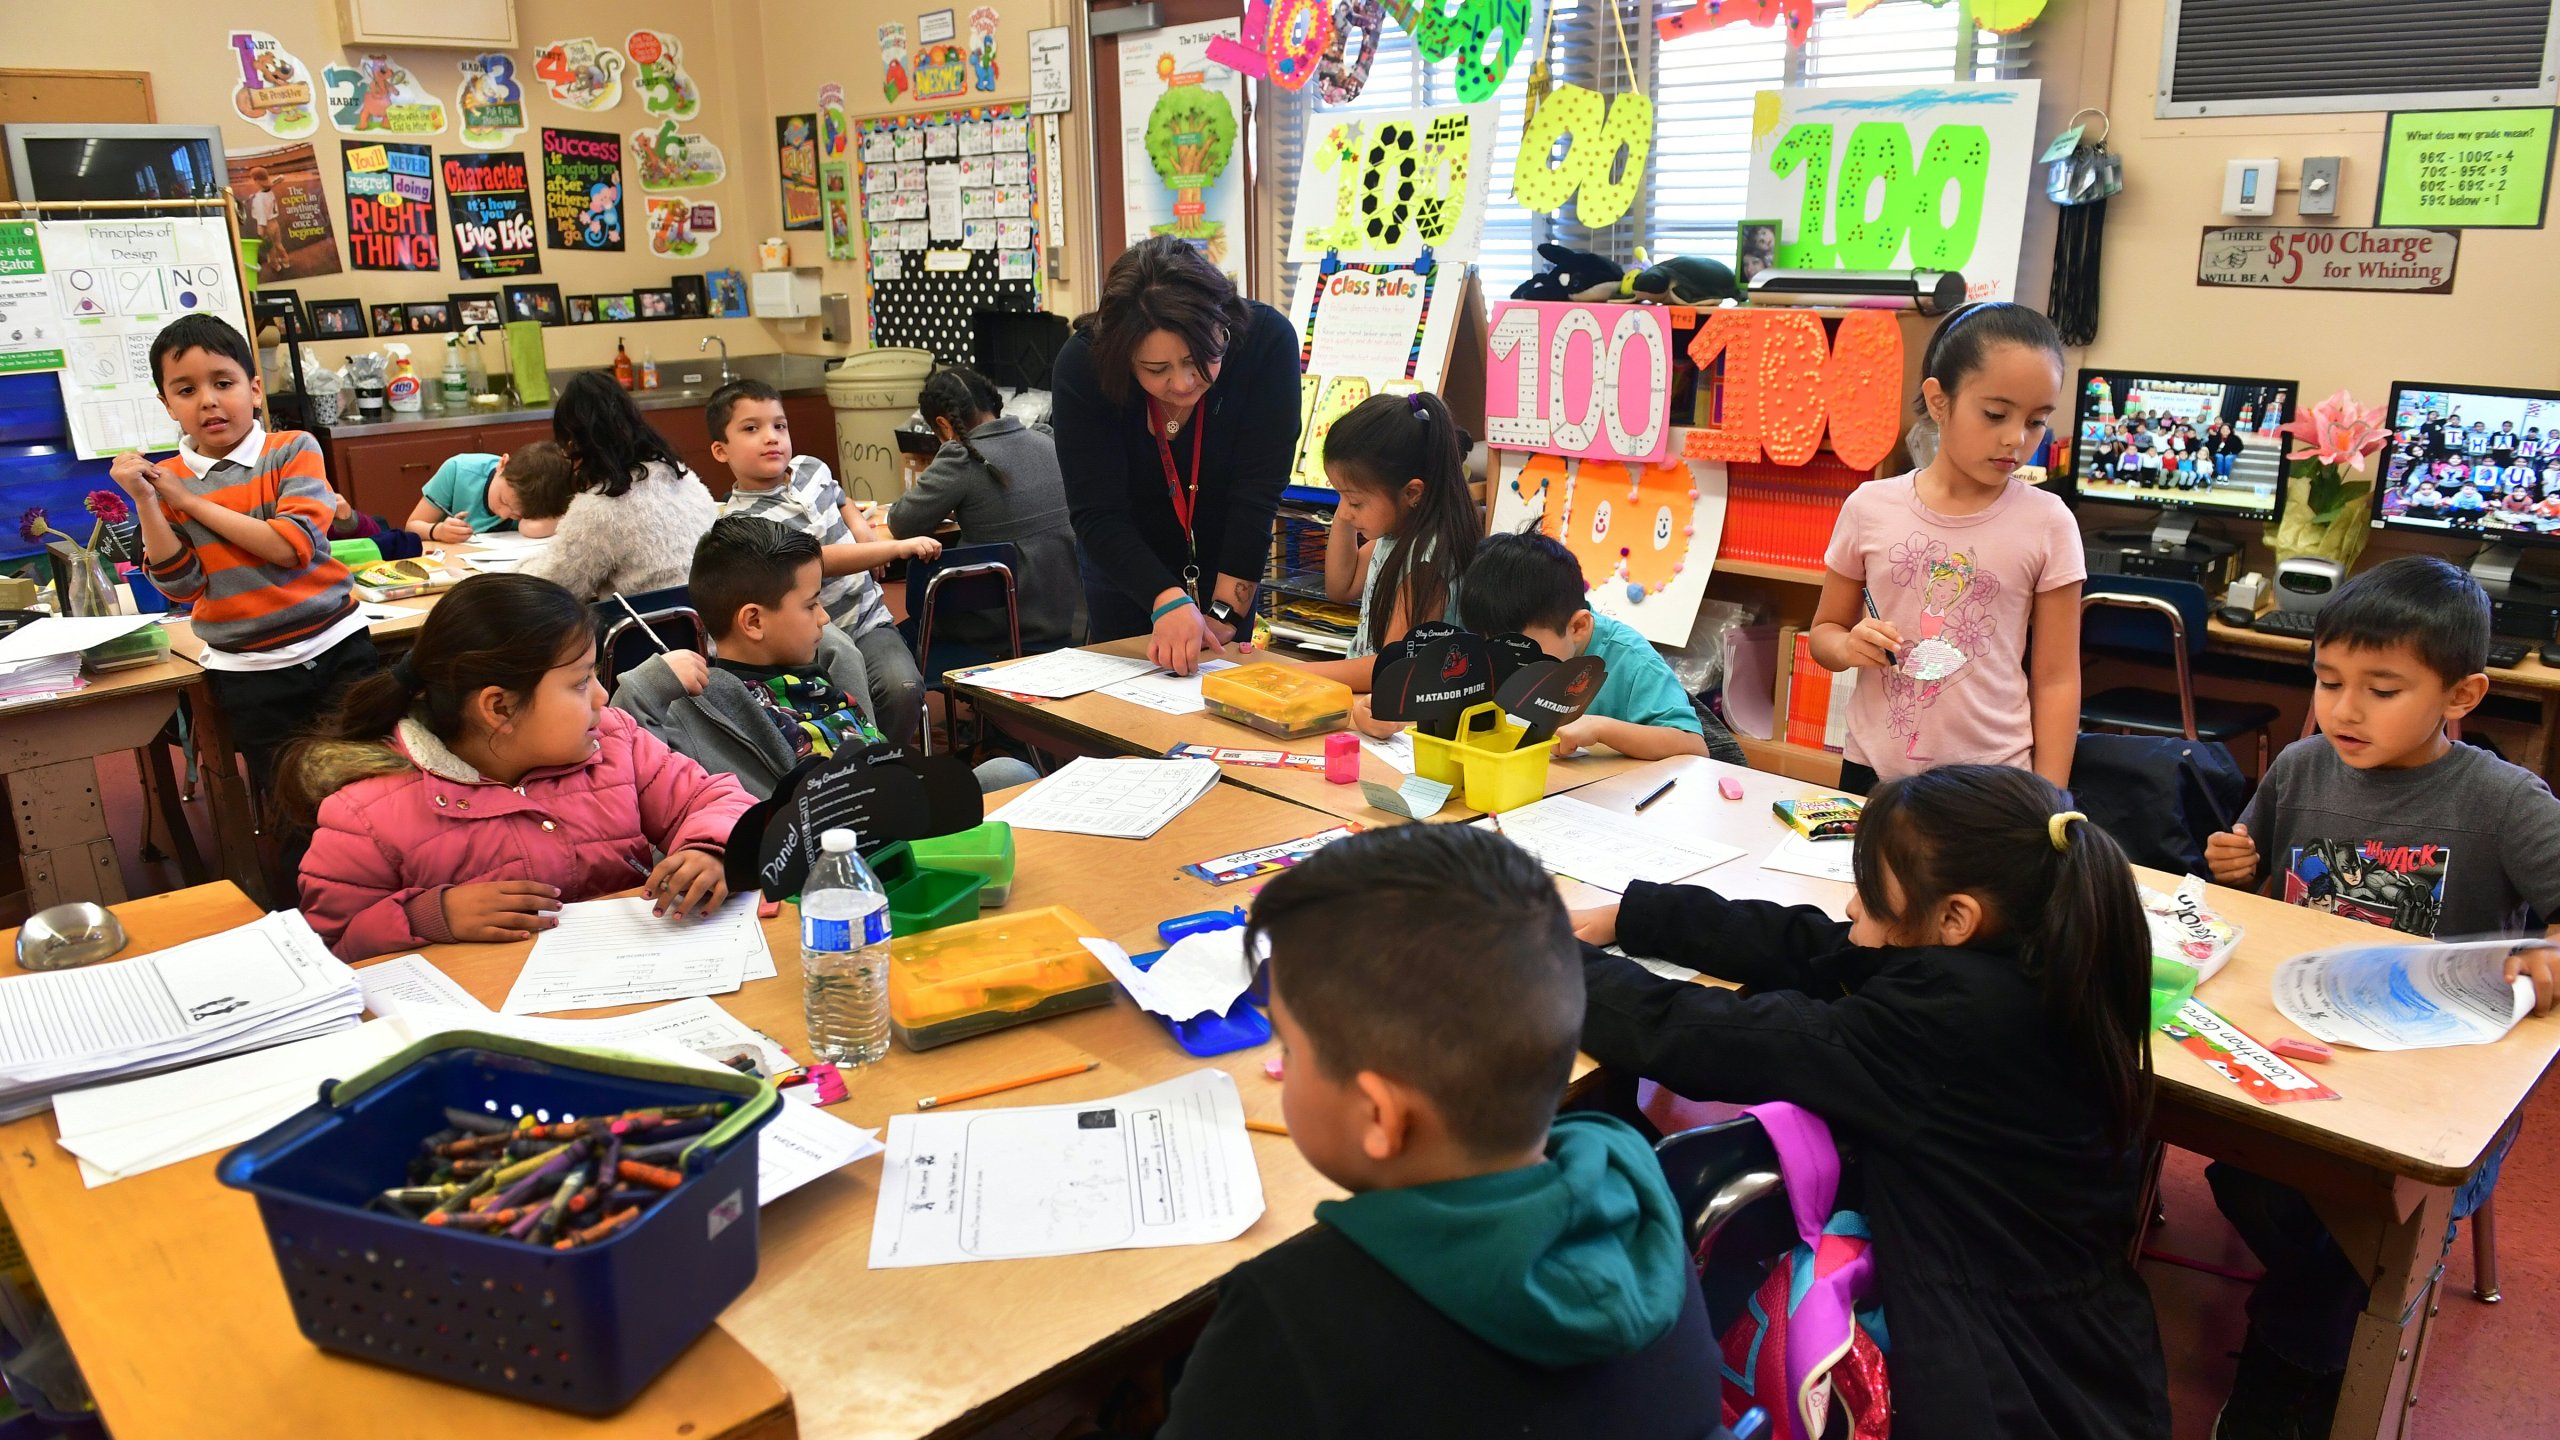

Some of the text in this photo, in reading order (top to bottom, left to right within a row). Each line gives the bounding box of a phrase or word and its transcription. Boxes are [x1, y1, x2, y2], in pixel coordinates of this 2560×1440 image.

[244, 41, 276, 50] HABIT
[1179, 36, 1191, 45] The
[1192, 35, 1198, 44] 7
[478, 54, 521, 101] 3
[535, 45, 577, 99] 4
[329, 97, 360, 106] HABIT
[655, 120, 689, 161] 6
[2407, 127, 2536, 142] What does my grade mean?
[543, 130, 619, 162] Success
[351, 147, 427, 174] You'll NEVER
[551, 152, 562, 165] is
[2419, 151, 2447, 164] 96%
[2458, 150, 2494, 163] 100%
[2505, 150, 2515, 162] 4
[545, 157, 617, 180] hanging on
[2420, 166, 2448, 178] 70%
[2460, 165, 2488, 177] 95%
[2500, 165, 2509, 176] 3
[348, 174, 430, 200] regret doing
[547, 175, 584, 191] after
[2419, 180, 2447, 192] 60%
[2497, 179, 2507, 191] 2
[287, 187, 303, 196] The
[383, 191, 397, 205] the
[547, 191, 590, 208] others
[1769, 122, 1991, 273] 100
[281, 195, 307, 207] expert
[488, 198, 517, 211] how
[2419, 194, 2446, 206] 59%
[2449, 194, 2482, 206] below
[2494, 194, 2501, 206] 1
[286, 203, 320, 215] anything
[299, 211, 315, 221] was
[351, 197, 433, 234] RIGHT
[547, 203, 579, 219] have
[292, 219, 319, 229] once a
[480, 210, 505, 225] you
[557, 217, 576, 232] let
[89, 223, 173, 244] Principles of
[287, 226, 325, 240] beginner
[455, 212, 535, 255] Live Life
[2220, 231, 2263, 241] THERE
[18, 246, 33, 256] for
[350, 233, 439, 269] THING!
[2339, 230, 2433, 261] Charge
[111, 248, 158, 264] Design
[2205, 272, 2269, 283] WILL BE A
[2323, 261, 2443, 284] for Whining
[1331, 276, 1418, 299] Class Rules
[391, 381, 412, 393] 409
[1487, 308, 1667, 457] 100
[1682, 309, 1905, 472] 100
[836, 422, 894, 471] Room
[1415, 627, 1455, 640] Stay Connected
[1415, 681, 1486, 704] MATADOR PRIDE
[1533, 697, 1571, 715] MATADOR
[866, 747, 904, 765] Connected
[806, 763, 858, 791] Stay Connected
[760, 821, 801, 887] Daniel
[1226, 844, 1287, 867] Vallejos
[2182, 1003, 2223, 1033] Garci
[2220, 1031, 2295, 1082] Jonathan
